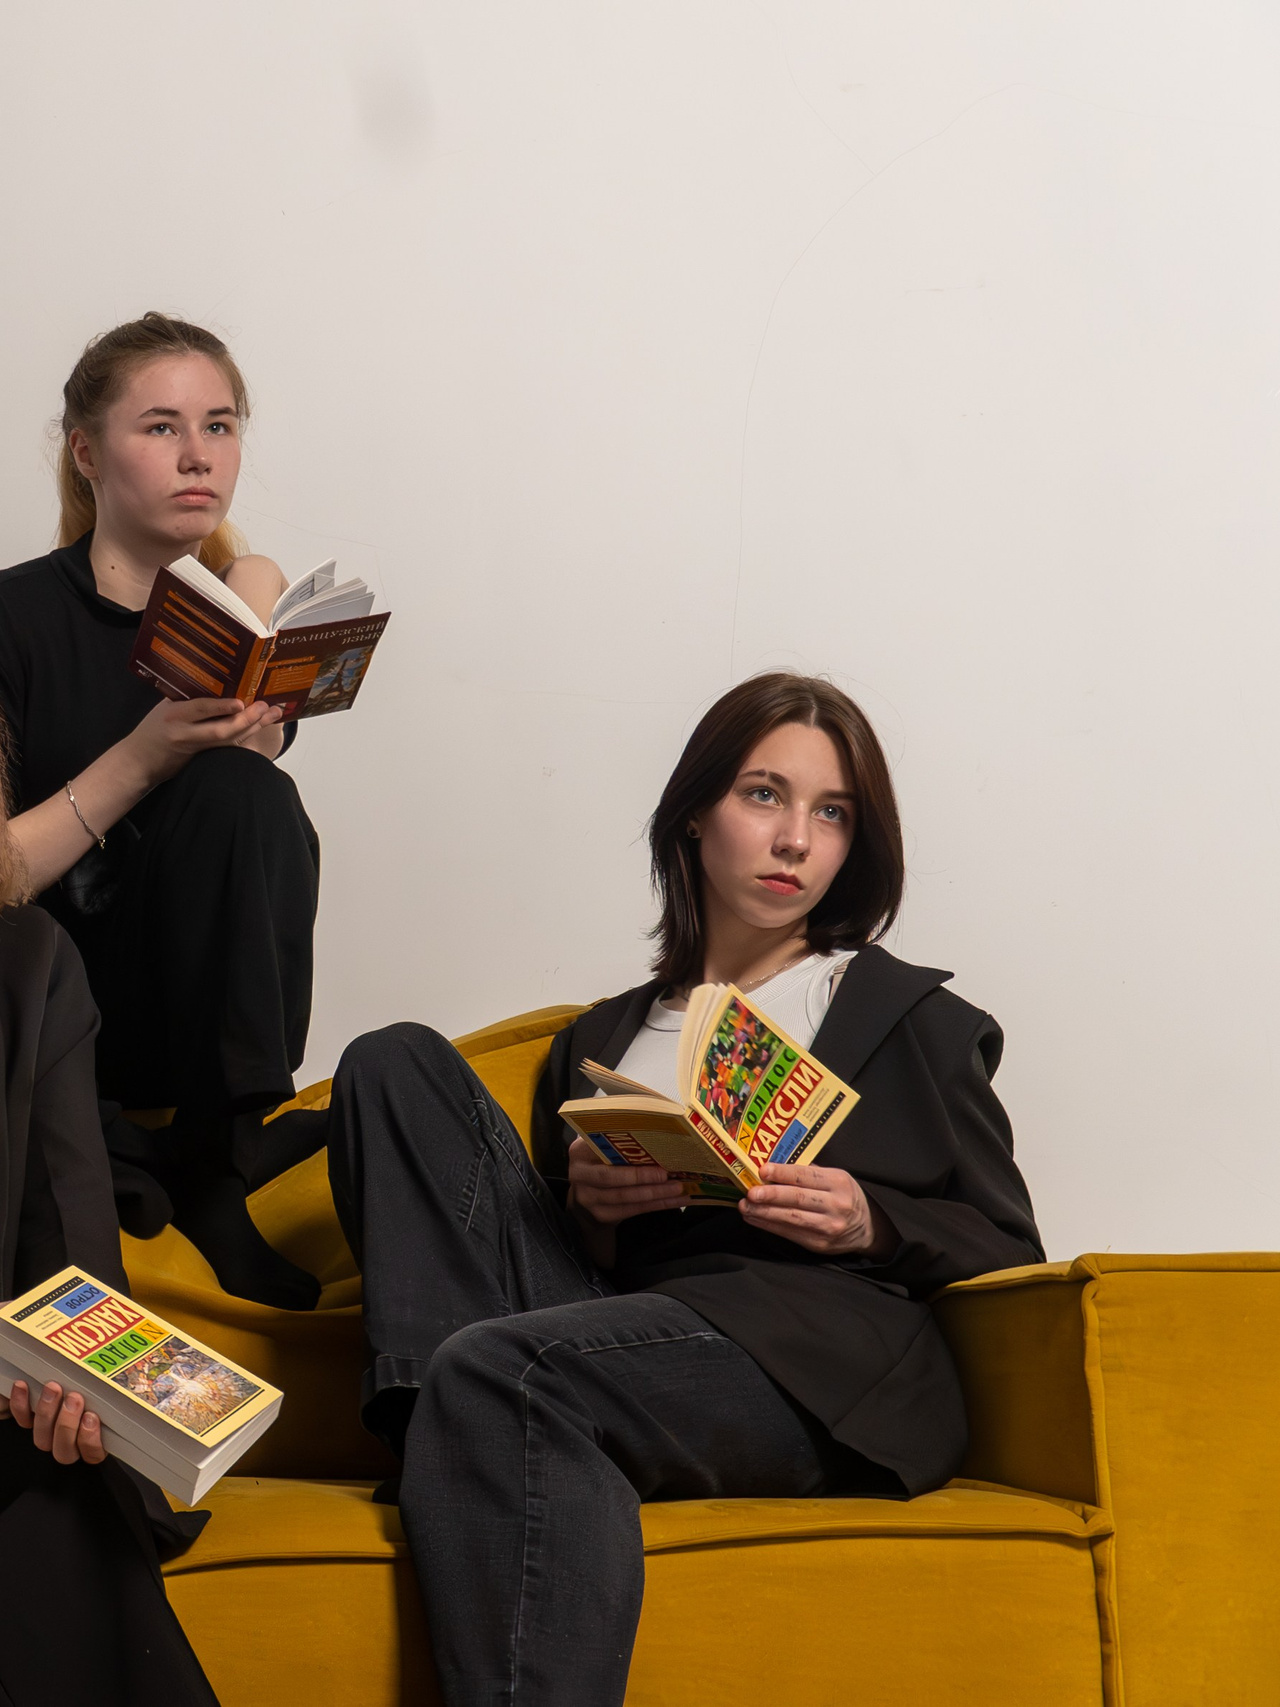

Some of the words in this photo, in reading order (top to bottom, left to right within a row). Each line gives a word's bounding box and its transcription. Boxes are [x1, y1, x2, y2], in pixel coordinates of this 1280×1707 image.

[279, 621, 385, 645] ФРАНЦУЗСКИЙ
[341, 631, 381, 645] ЯЗЫК
[746, 1048, 797, 1125] ОЛДОС
[749, 1061, 821, 1166] ХАКСЛИ
[65, 1287, 100, 1310] ОСТРОВ
[50, 1298, 141, 1357] ХАКСЛИ
[87, 1333, 149, 1373] ОЛДОС
